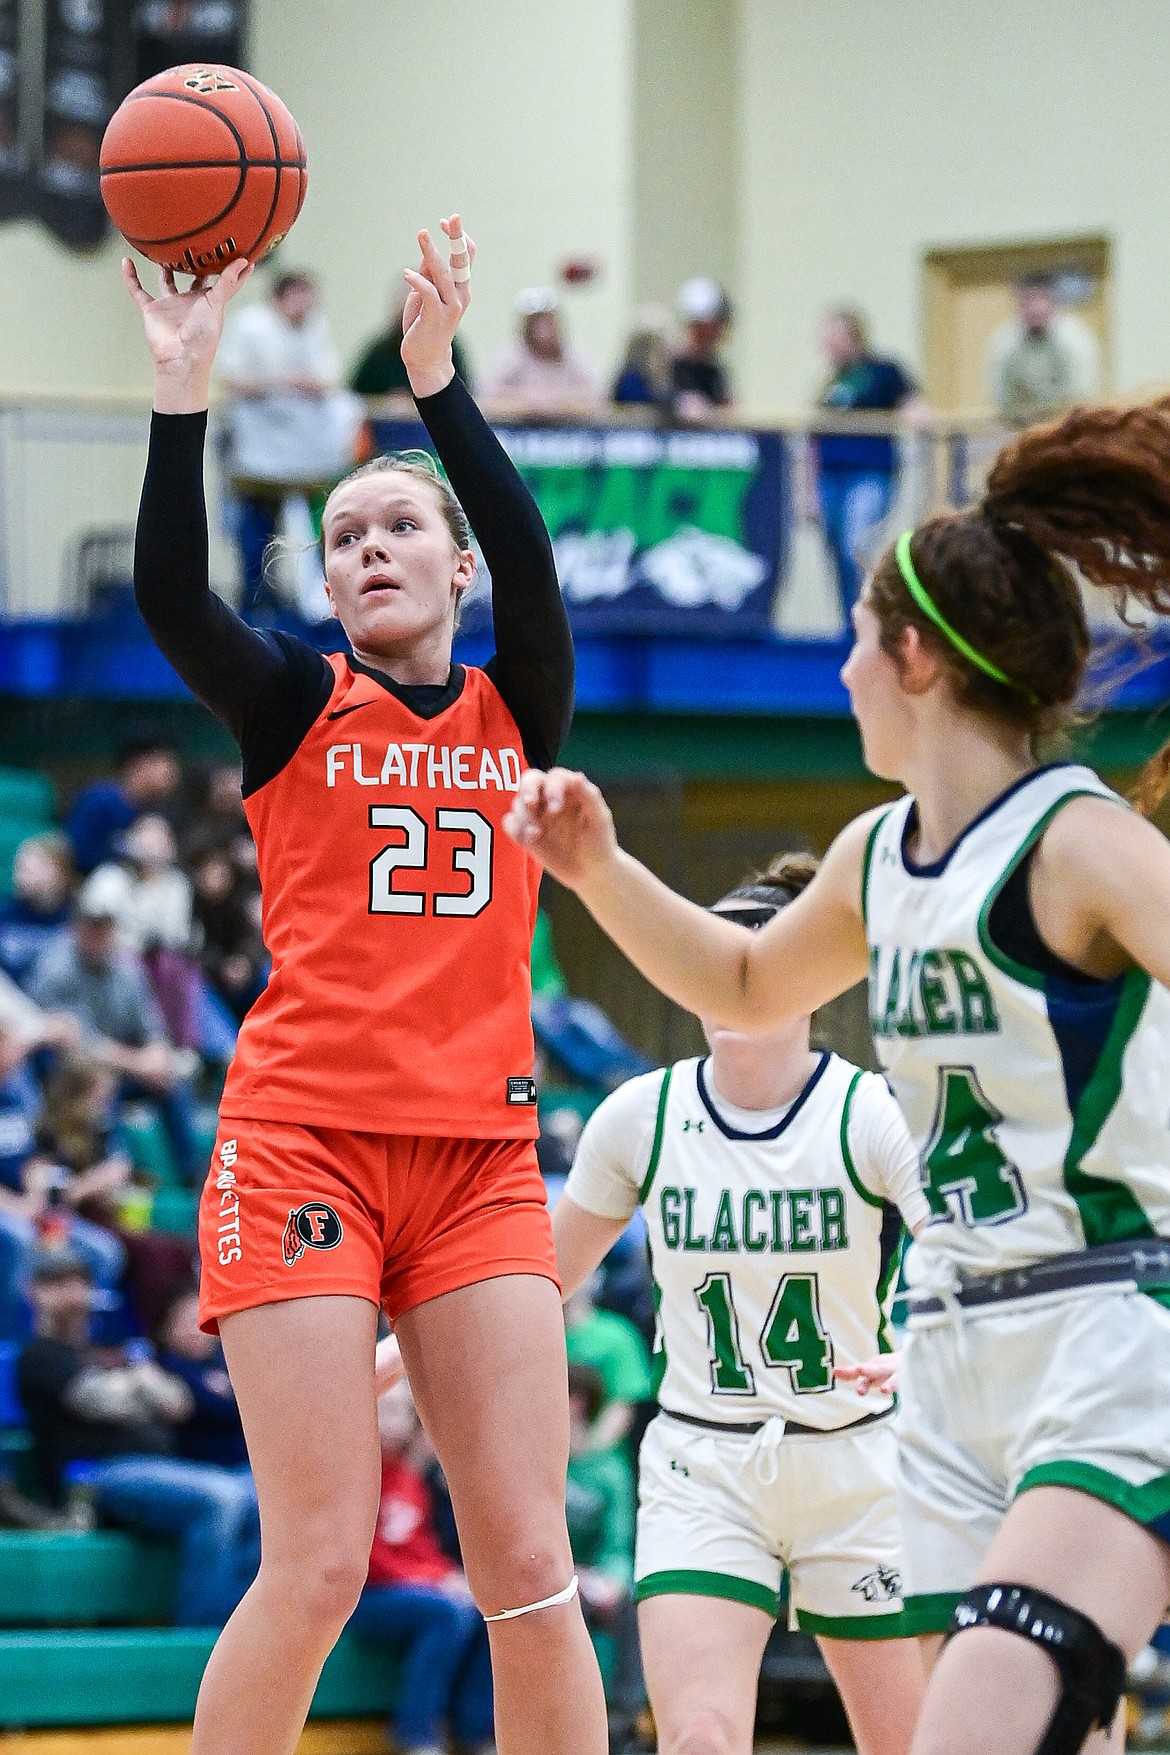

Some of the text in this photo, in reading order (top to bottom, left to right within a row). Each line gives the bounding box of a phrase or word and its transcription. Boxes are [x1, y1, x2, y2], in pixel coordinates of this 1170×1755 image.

[326, 743, 522, 792] FLATHEAD
[368, 804, 494, 918] 23
[305, 1211, 329, 1242] F
[660, 1186, 850, 1253] GLACIER
[693, 1272, 836, 1396] 14
